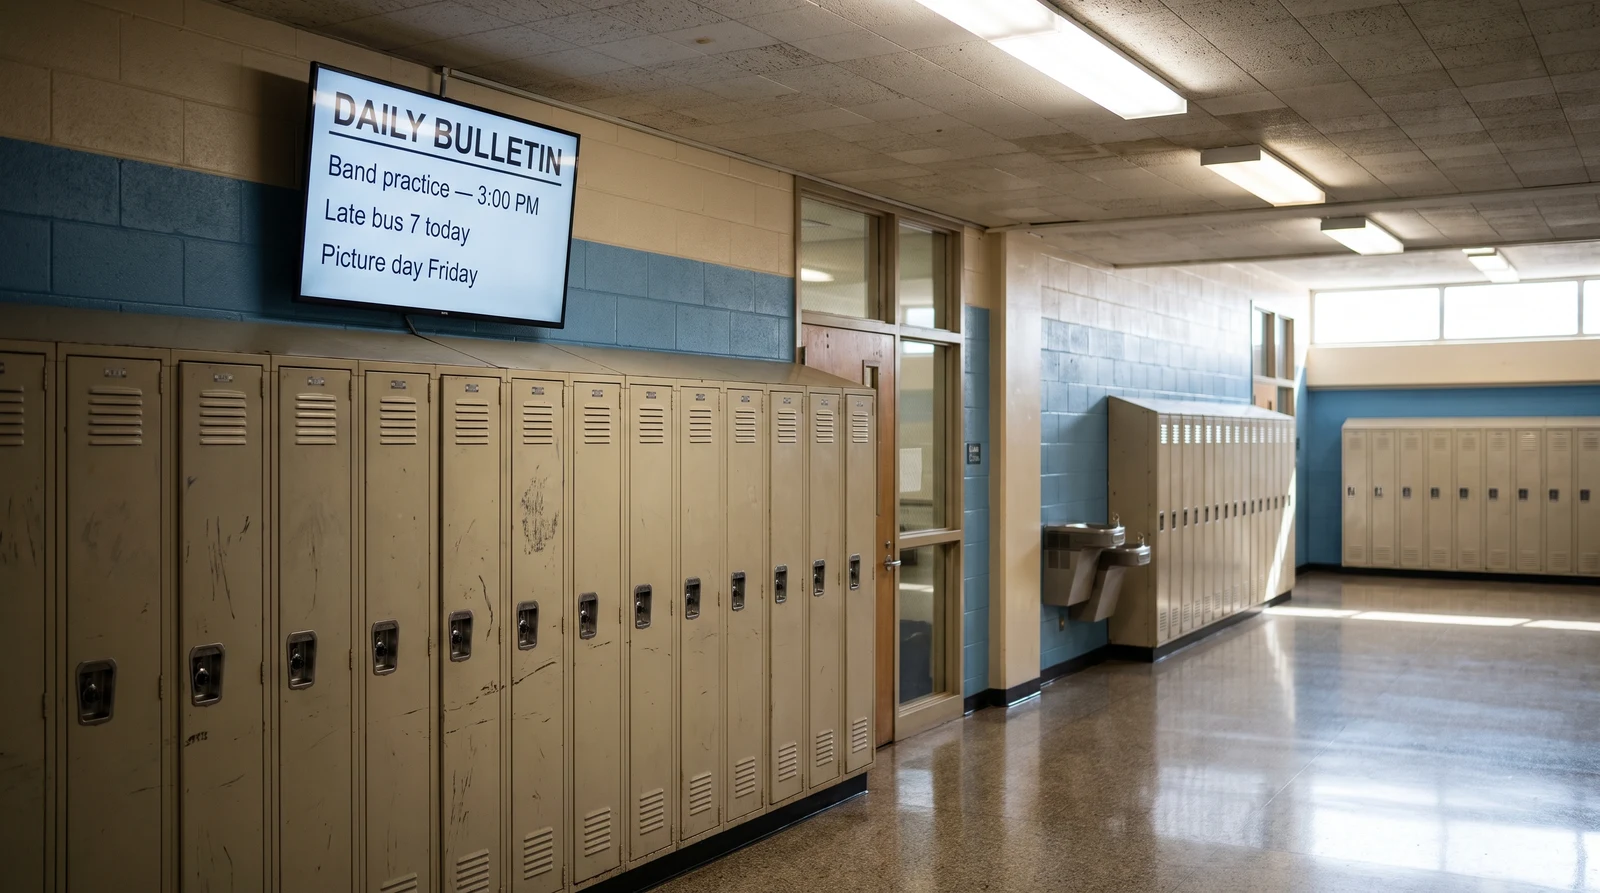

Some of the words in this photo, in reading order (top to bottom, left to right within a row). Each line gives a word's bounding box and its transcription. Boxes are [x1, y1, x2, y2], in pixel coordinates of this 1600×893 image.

[334, 91, 426, 143] DAILY
[433, 117, 562, 176] BULLETIN
[328, 154, 377, 184] Band
[383, 171, 450, 197] practice
[477, 185, 510, 209] 3:00
[515, 193, 539, 215] PM
[325, 198, 366, 225] Late
[372, 207, 403, 231] bus
[410, 213, 420, 234] 7
[426, 220, 470, 247] today
[321, 244, 386, 272] Picture
[391, 254, 423, 282] day
[428, 258, 478, 288] Friday
